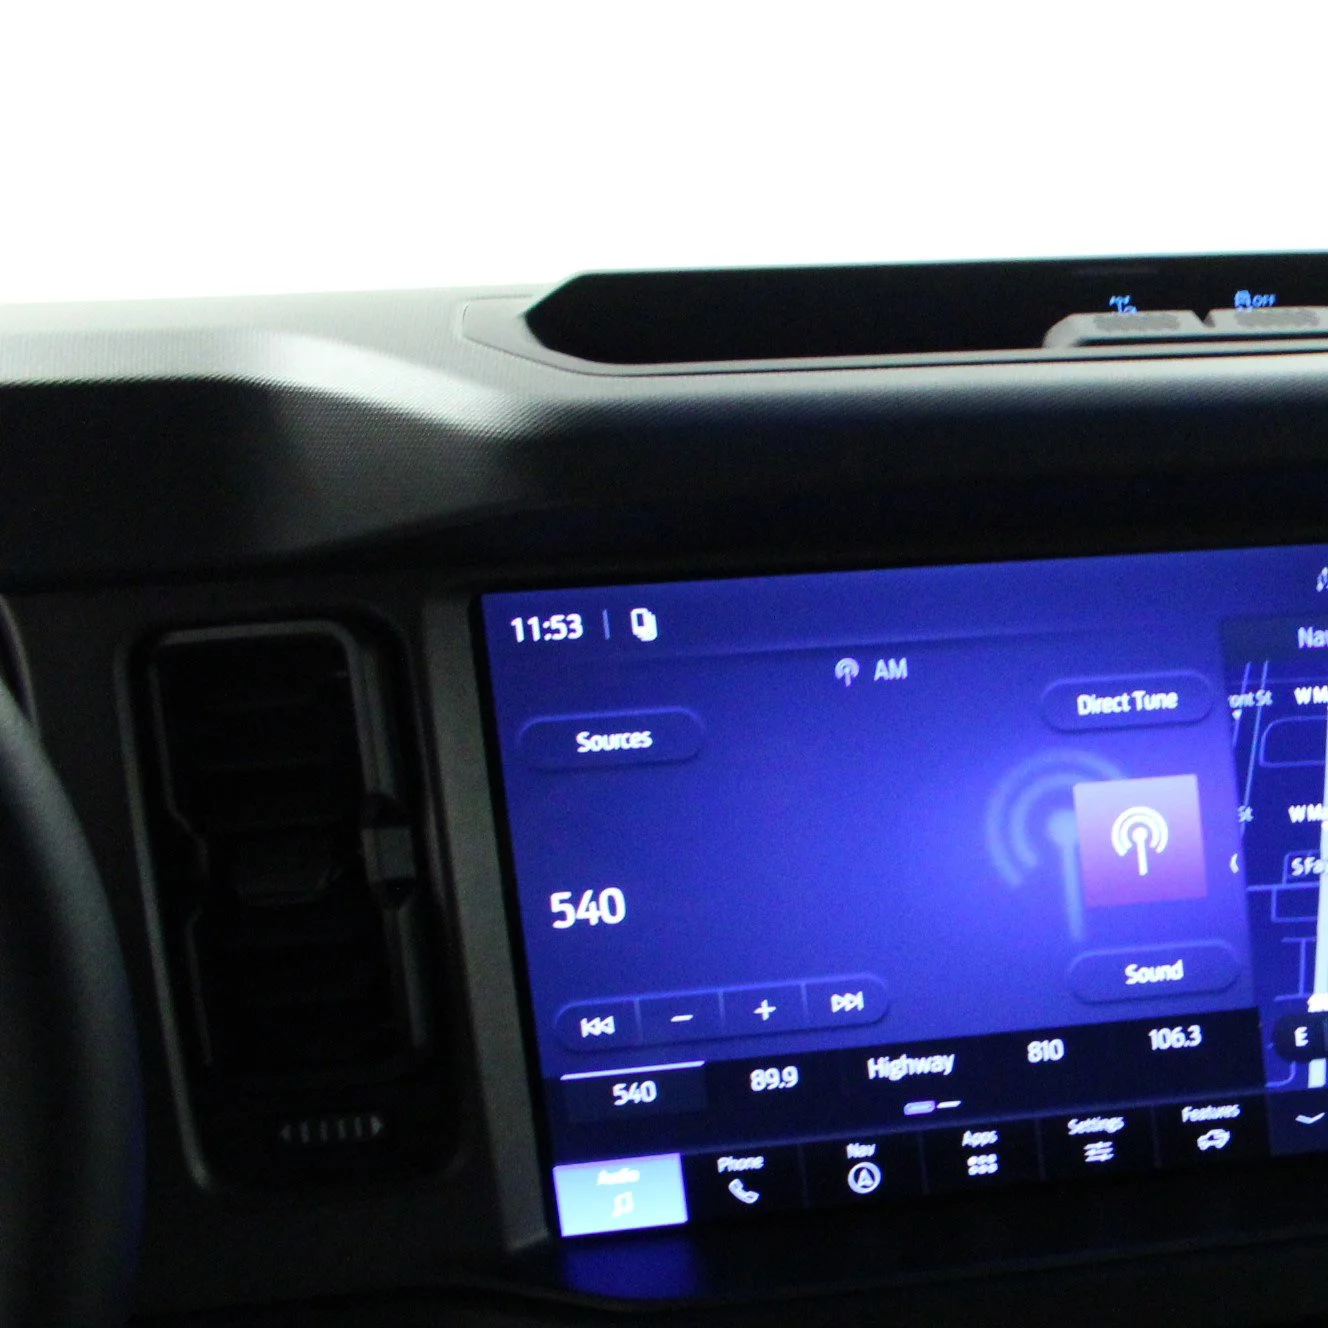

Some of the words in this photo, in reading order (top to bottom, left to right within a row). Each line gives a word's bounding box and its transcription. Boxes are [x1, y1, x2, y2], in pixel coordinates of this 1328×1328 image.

[510, 613, 584, 643] 11:53
[873, 657, 908, 681] AM
[1076, 692, 1133, 716] Direct
[1131, 689, 1179, 712] Tune
[1293, 686, 1313, 705] W
[575, 730, 654, 753] Sources
[1287, 804, 1307, 824] W
[549, 886, 627, 929] 540
[1124, 959, 1185, 985] Sound
[1148, 1024, 1202, 1051] 106.3
[1293, 1026, 1309, 1047] E
[1027, 1038, 1065, 1063] 810
[749, 1065, 799, 1092] 89.9
[866, 1053, 955, 1082] Highway
[611, 1079, 659, 1107] 540
[1181, 1104, 1241, 1123] Features
[1067, 1116, 1125, 1136] Settings
[846, 1142, 876, 1160] Nav
[961, 1130, 999, 1148] Apps
[716, 1155, 765, 1173] Phone
